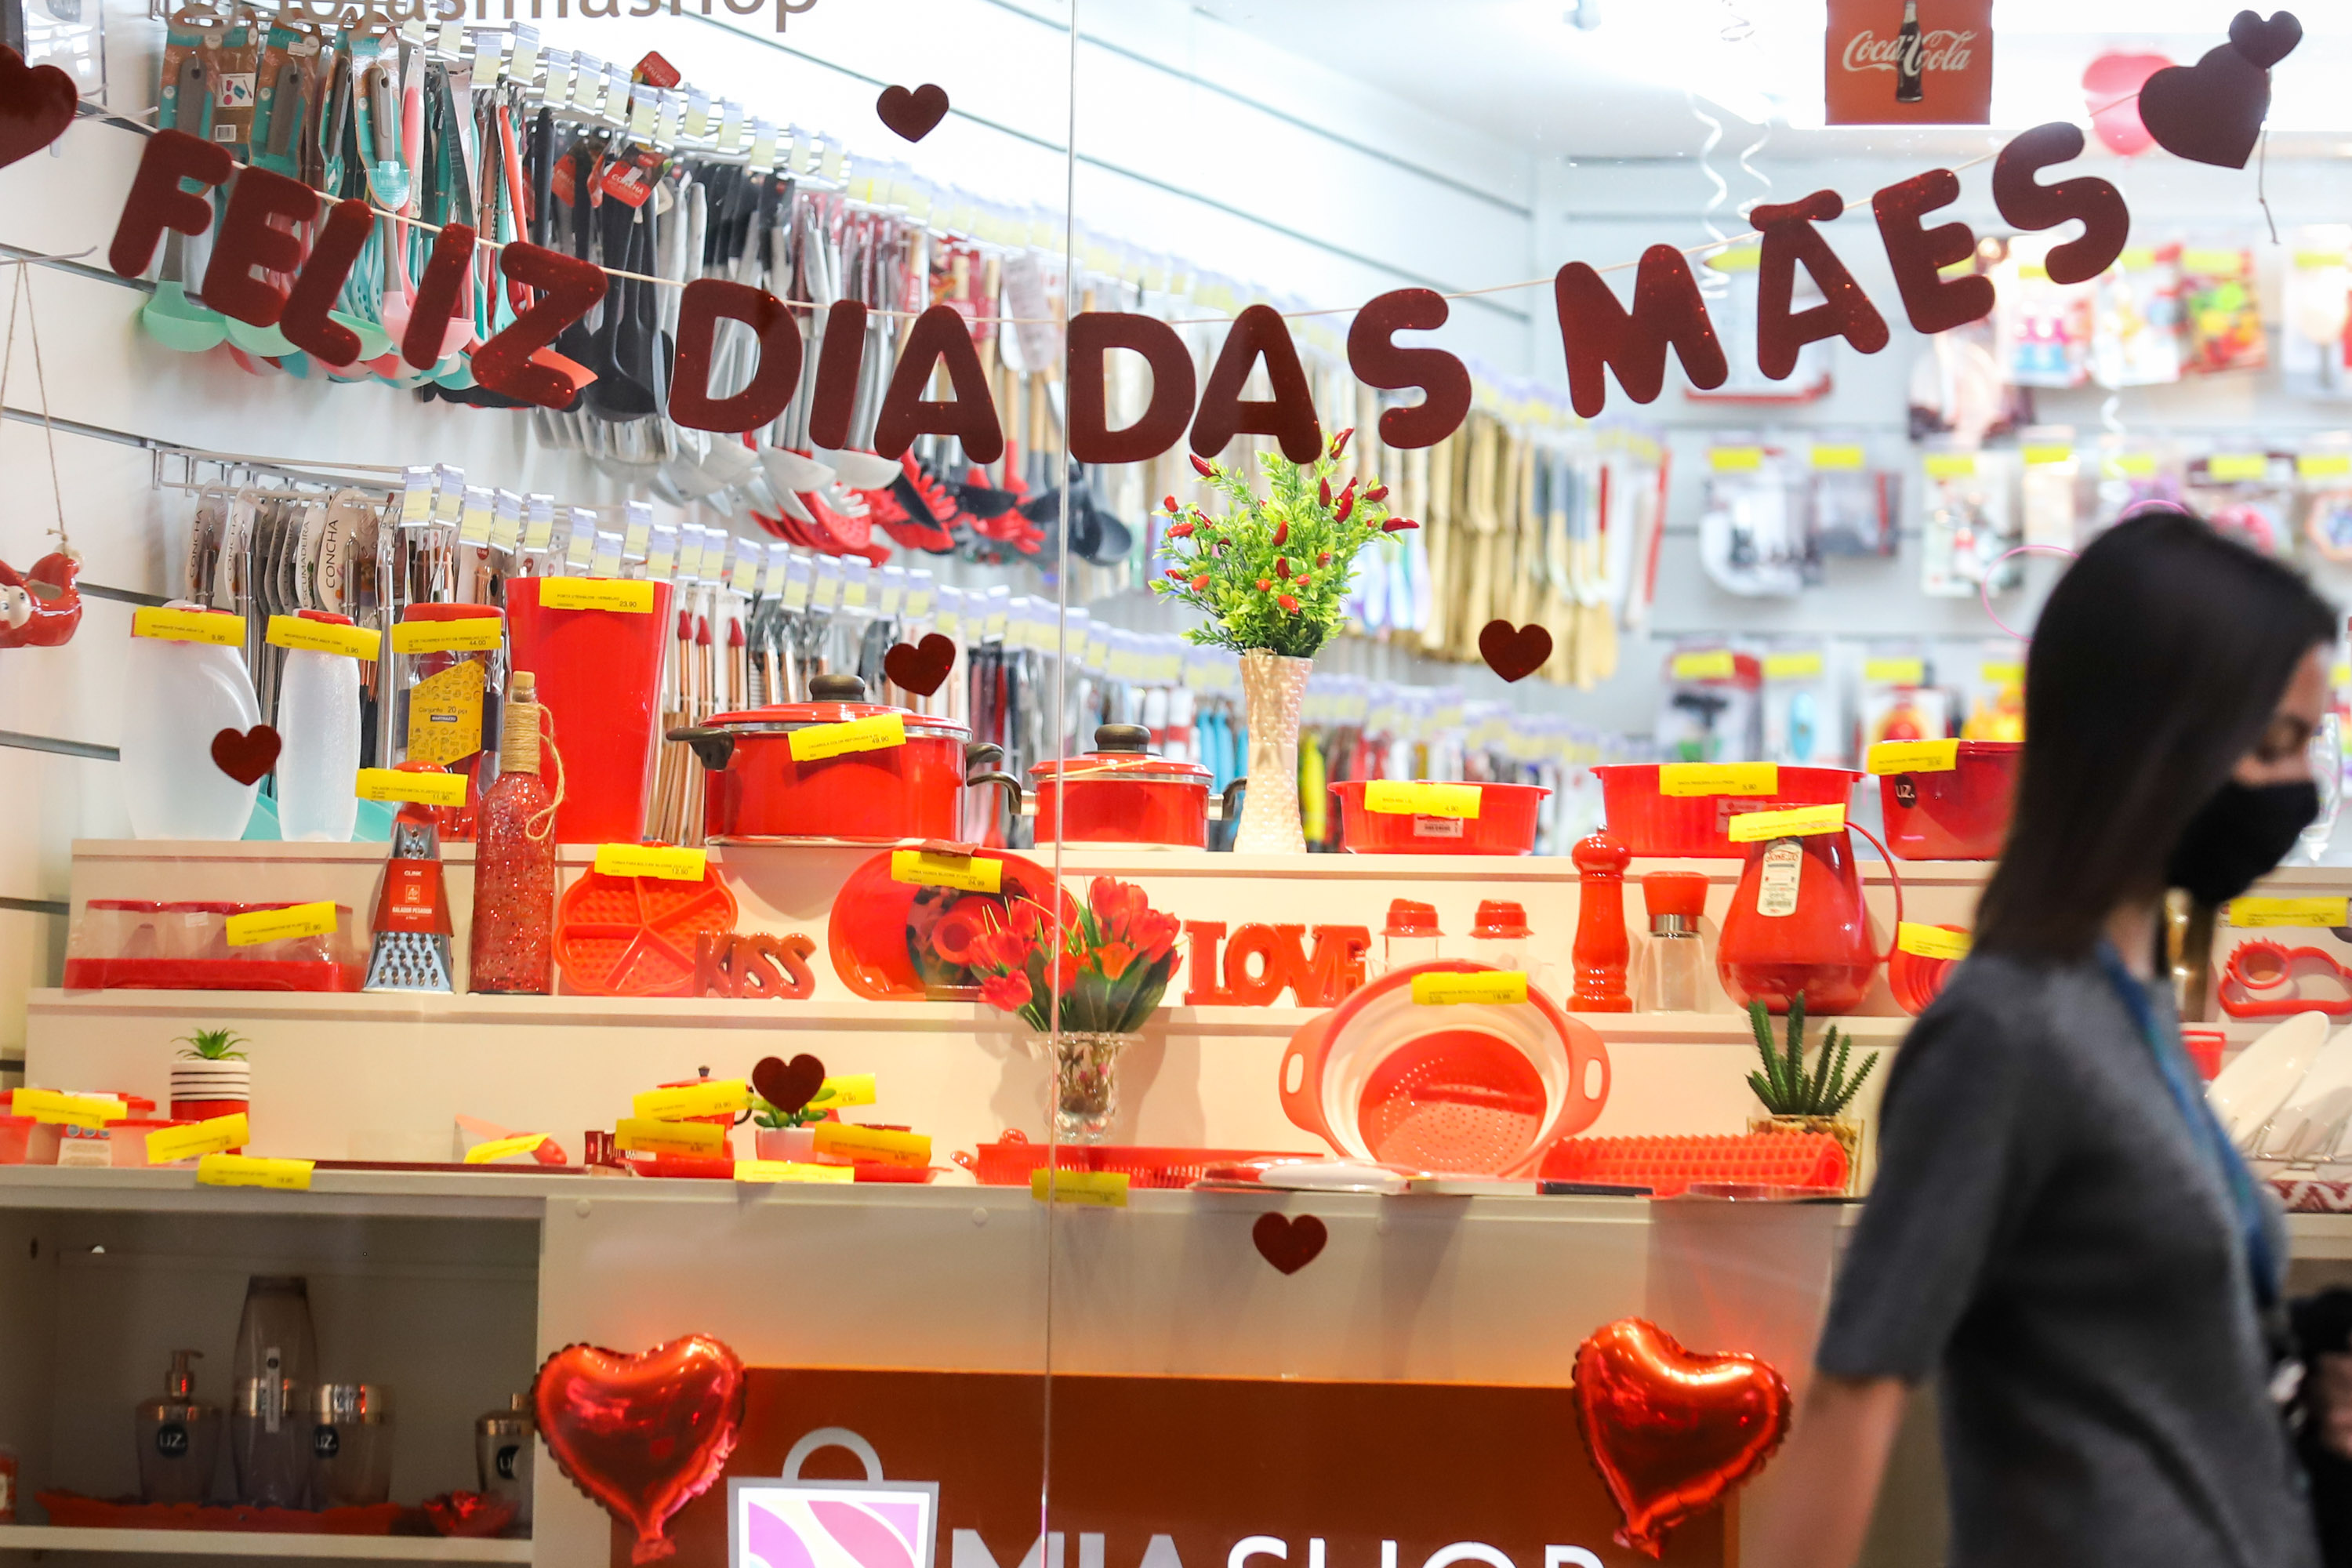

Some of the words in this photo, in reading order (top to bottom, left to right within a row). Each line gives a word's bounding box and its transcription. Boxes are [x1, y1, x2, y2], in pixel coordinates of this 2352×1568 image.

[1842, 30, 1977, 76] Coca-Cola
[612, 173, 644, 195] COHA
[108, 129, 608, 410] FELIZ
[669, 278, 1004, 465] DIA
[1069, 287, 1472, 465] DAS
[1555, 122, 2131, 419] MÃES
[325, 519, 339, 588] CONCHA
[693, 931, 817, 1000] KISS
[1181, 919, 1372, 1008] LOVE
